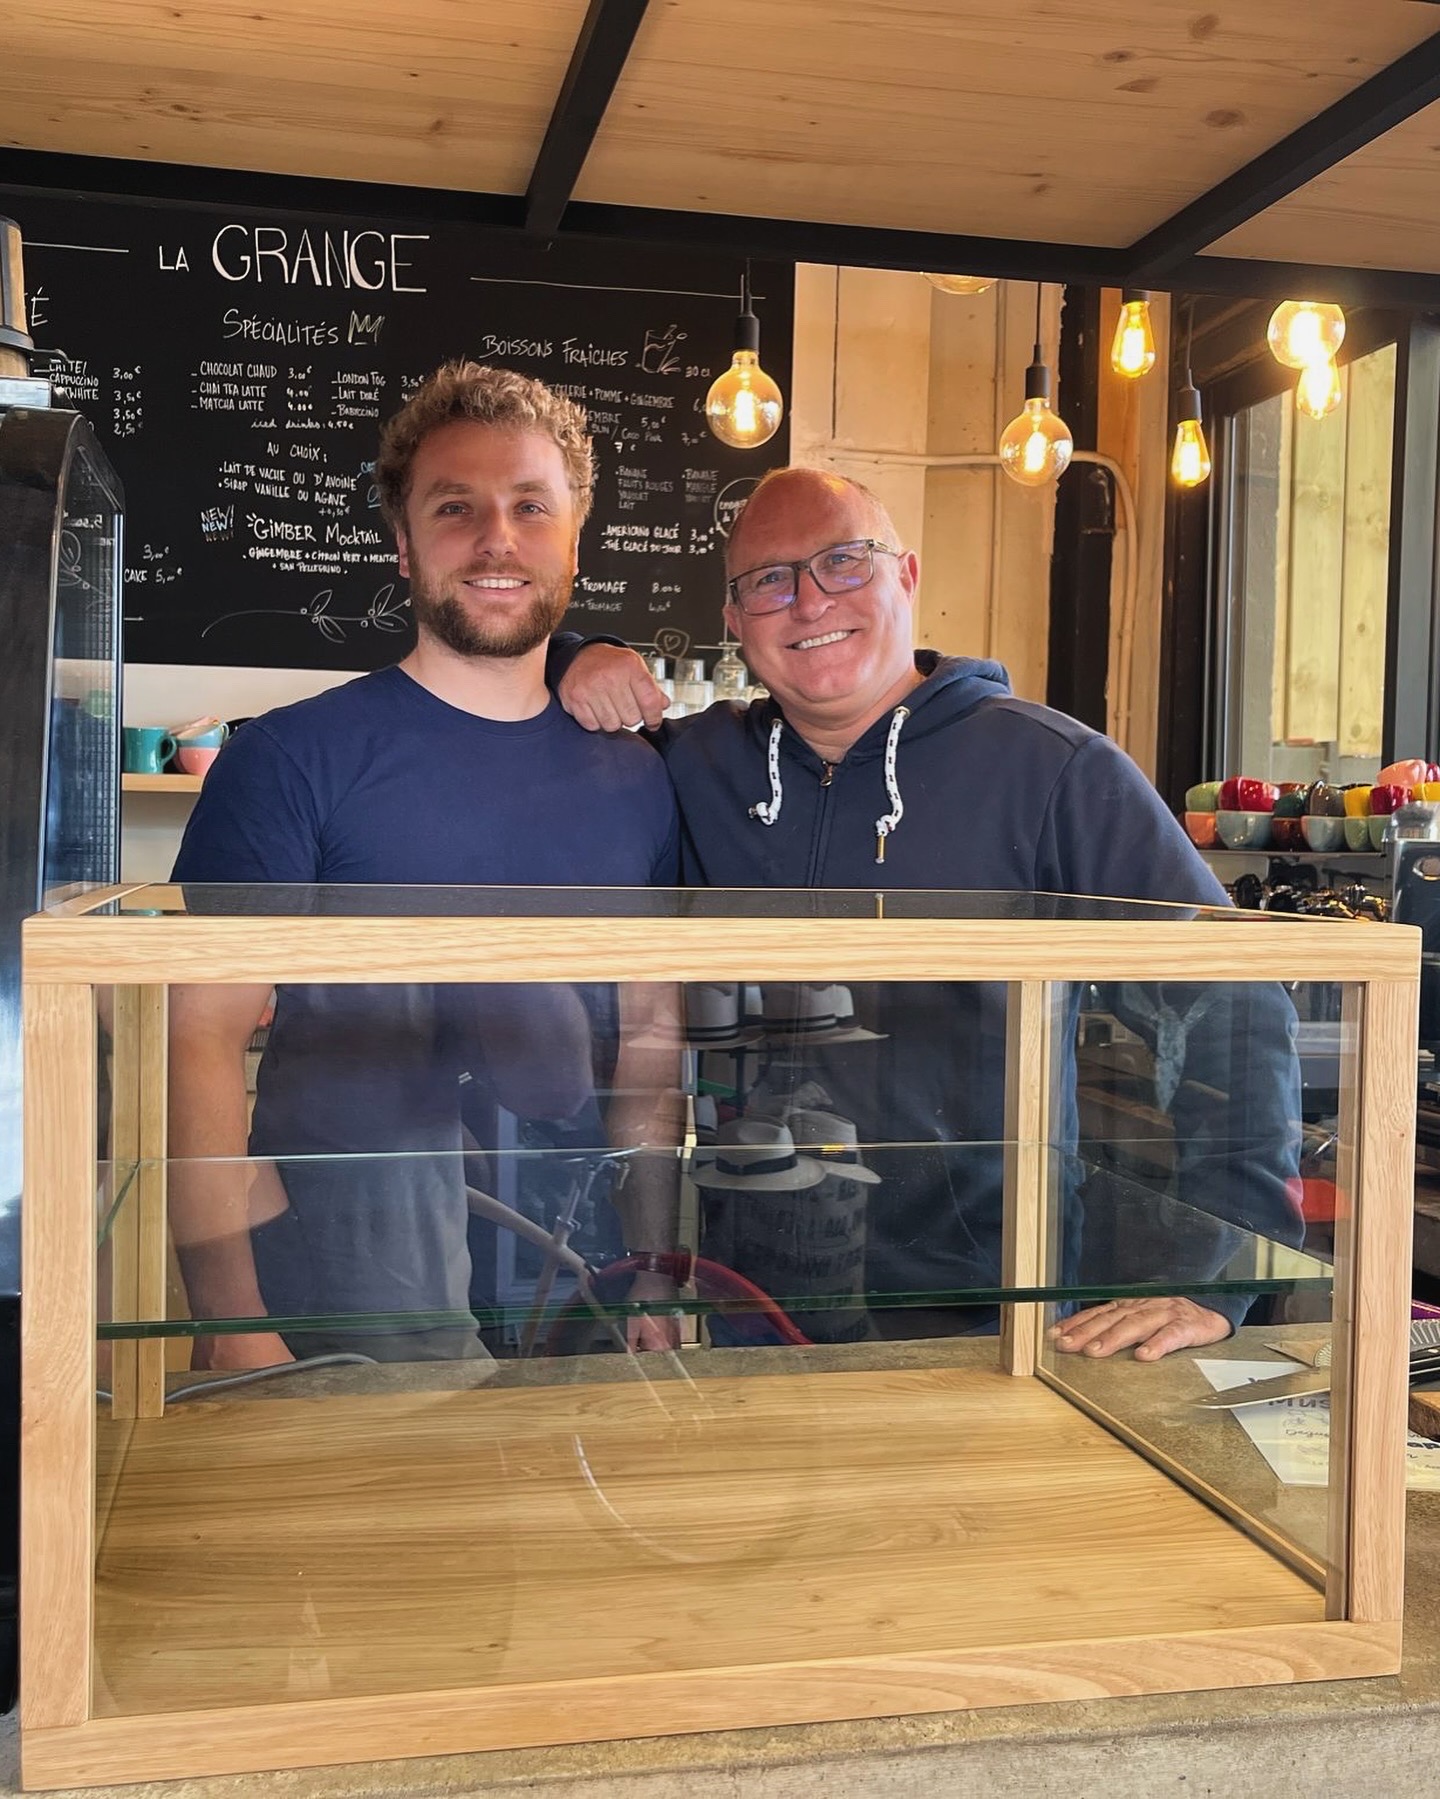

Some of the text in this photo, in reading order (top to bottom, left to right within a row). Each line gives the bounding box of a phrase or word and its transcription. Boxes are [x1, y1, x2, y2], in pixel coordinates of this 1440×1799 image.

[159, 224, 430, 293] LA GRANGE
[223, 308, 339, 346] SPÉCIALITÉS
[479, 334, 553, 359] BOISSONS
[200, 361, 243, 378] CHOCOLAT
[247, 363, 277, 379] CHAUD
[337, 371, 369, 385] LONDON
[685, 366, 699, 378] 30
[49, 372, 99, 387] CAPPUCCINO
[200, 381, 220, 395] CHAI
[223, 383, 239, 396] TEA
[241, 385, 267, 398] LATTE
[338, 386, 379, 401] LAIT DORÉ
[594, 388, 623, 403] POMME
[199, 396, 234, 411] MATCHA
[238, 398, 264, 411] LATTE
[267, 441, 279, 457] AU
[223, 461, 357, 491] LAIT DE VACHE OU D'AVOINE
[223, 477, 347, 507] SIROP VANILLE OU AGAVE
[201, 504, 234, 523] NEW!
[202, 518, 233, 533] NEW!
[253, 518, 317, 543] GIMBER
[606, 524, 649, 537] AMERICANO
[653, 522, 679, 539] GLACÉ
[605, 538, 621, 551] THÉ
[623, 540, 648, 552] GLACÉ
[662, 545, 682, 554] JOUR
[249, 547, 302, 561] GINGEMBRE
[311, 550, 341, 561] CITRON
[342, 551, 361, 563] VERT
[370, 554, 399, 564] MENTHE
[123, 568, 147, 583] CAKE
[280, 563, 294, 571] SAN
[581, 577, 628, 594] FROMAGE
